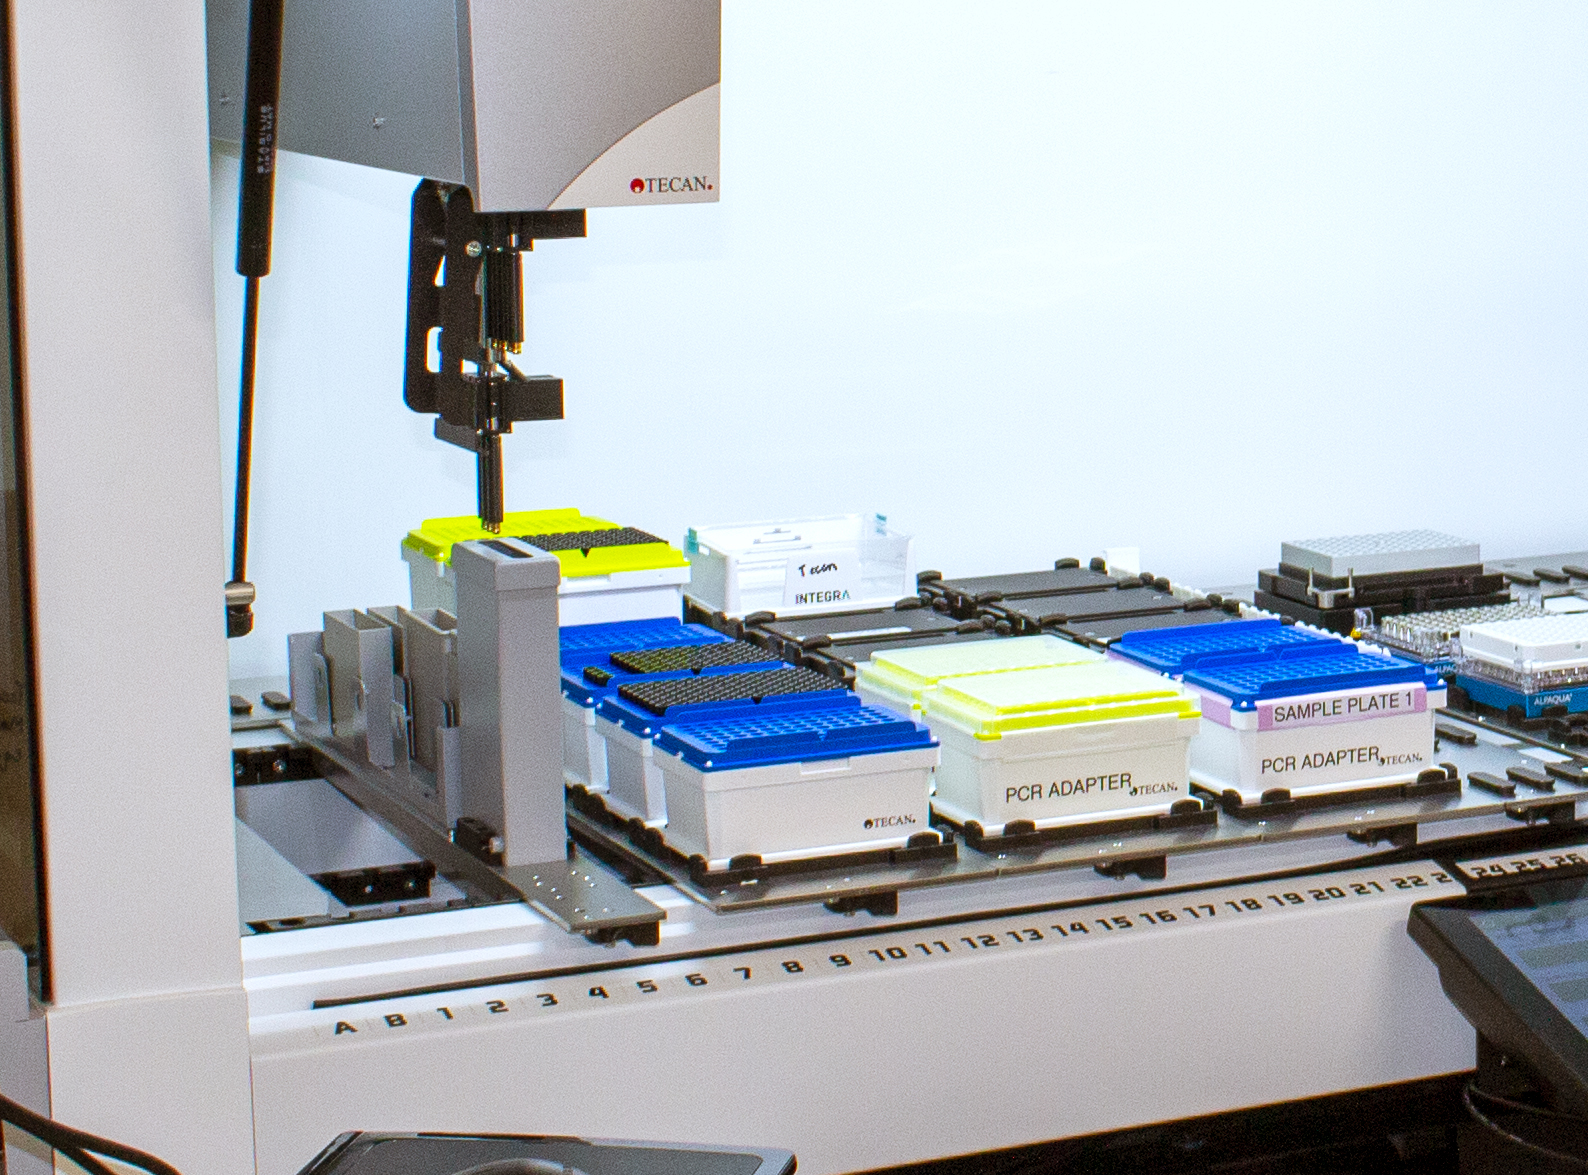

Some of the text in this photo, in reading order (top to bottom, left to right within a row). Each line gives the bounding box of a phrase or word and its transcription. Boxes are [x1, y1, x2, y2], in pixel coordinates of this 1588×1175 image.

[795, 590, 851, 604] INTEGRA
[1274, 691, 1412, 723] SAMPLE PLATE 1
[1261, 746, 1380, 774] PCR ADAPTER
[1005, 772, 1132, 803] PCR ADAPTER
[1470, 864, 1507, 876] 24
[335, 1022, 357, 1035] A
[384, 1014, 407, 1027] B
[437, 1008, 453, 1020] 1
[487, 1001, 508, 1013] 2
[537, 994, 558, 1006] 3
[589, 987, 608, 998] 4
[637, 980, 657, 993] 5
[685, 974, 707, 986] 6
[734, 967, 750, 979] 7
[782, 961, 803, 973] 8
[829, 955, 851, 967] 9
[869, 947, 907, 961] 10
[915, 941, 950, 955] 11
[961, 935, 999, 949] 12
[1006, 929, 1043, 942] 13
[1051, 923, 1089, 936] 14
[1096, 916, 1132, 930] 15
[1139, 910, 1177, 924] 16
[1183, 905, 1215, 918] 17
[1225, 899, 1262, 912] 18
[1268, 893, 1304, 906] 19
[1308, 887, 1346, 901] 20
[1350, 882, 1384, 895] 21
[1391, 876, 1428, 889] 22
